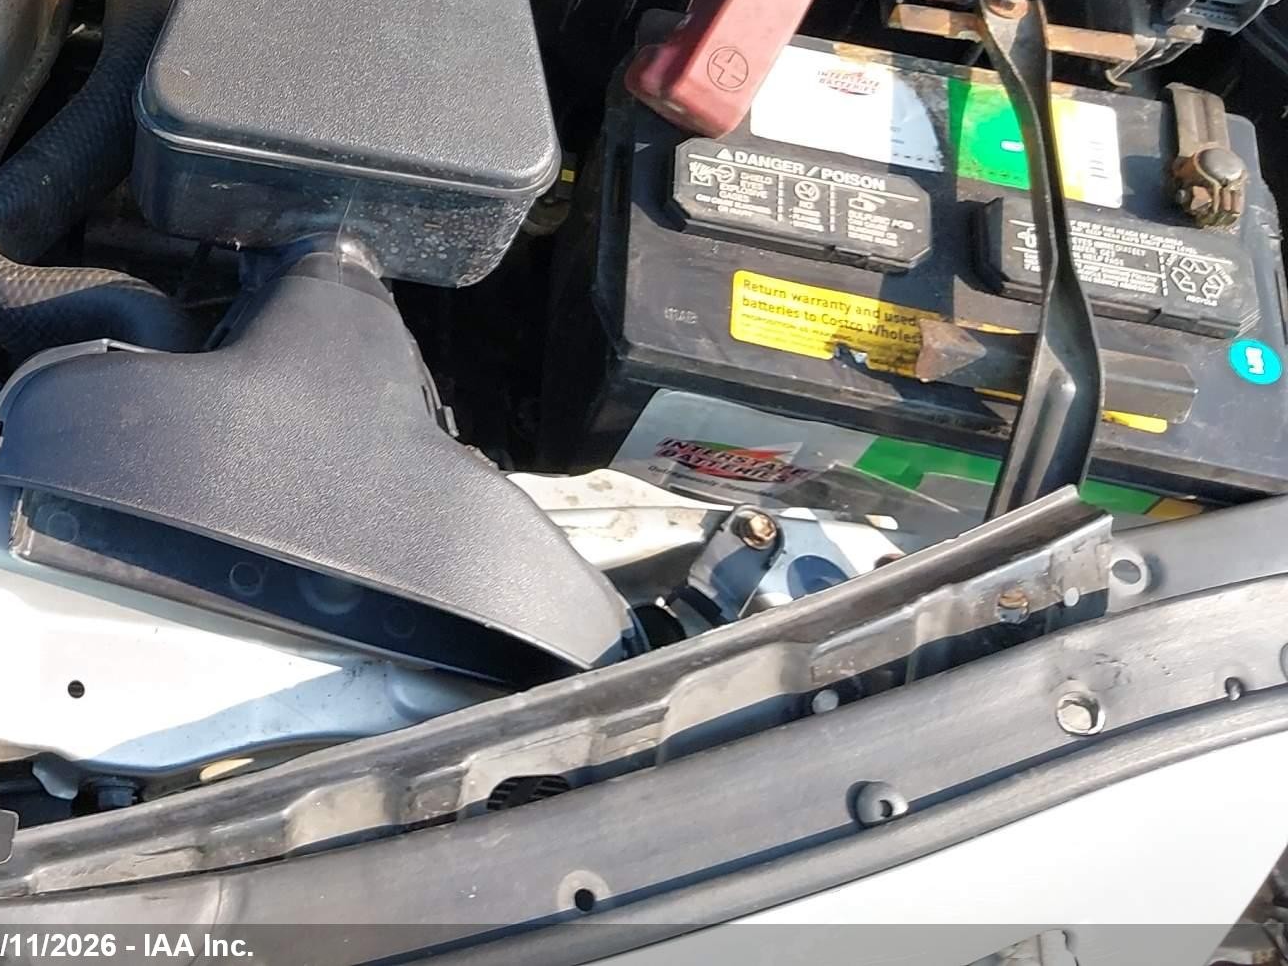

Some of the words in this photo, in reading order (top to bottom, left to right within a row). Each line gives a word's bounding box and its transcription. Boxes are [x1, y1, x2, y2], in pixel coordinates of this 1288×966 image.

[733, 151, 805, 175] DANGER
[820, 167, 887, 191] POISON
[742, 279, 787, 299] Return
[791, 292, 852, 315] warranty
[855, 304, 881, 319] and
[883, 311, 918, 328] used
[742, 296, 800, 319] batteries
[804, 309, 818, 323] to
[820, 313, 864, 332] Costco
